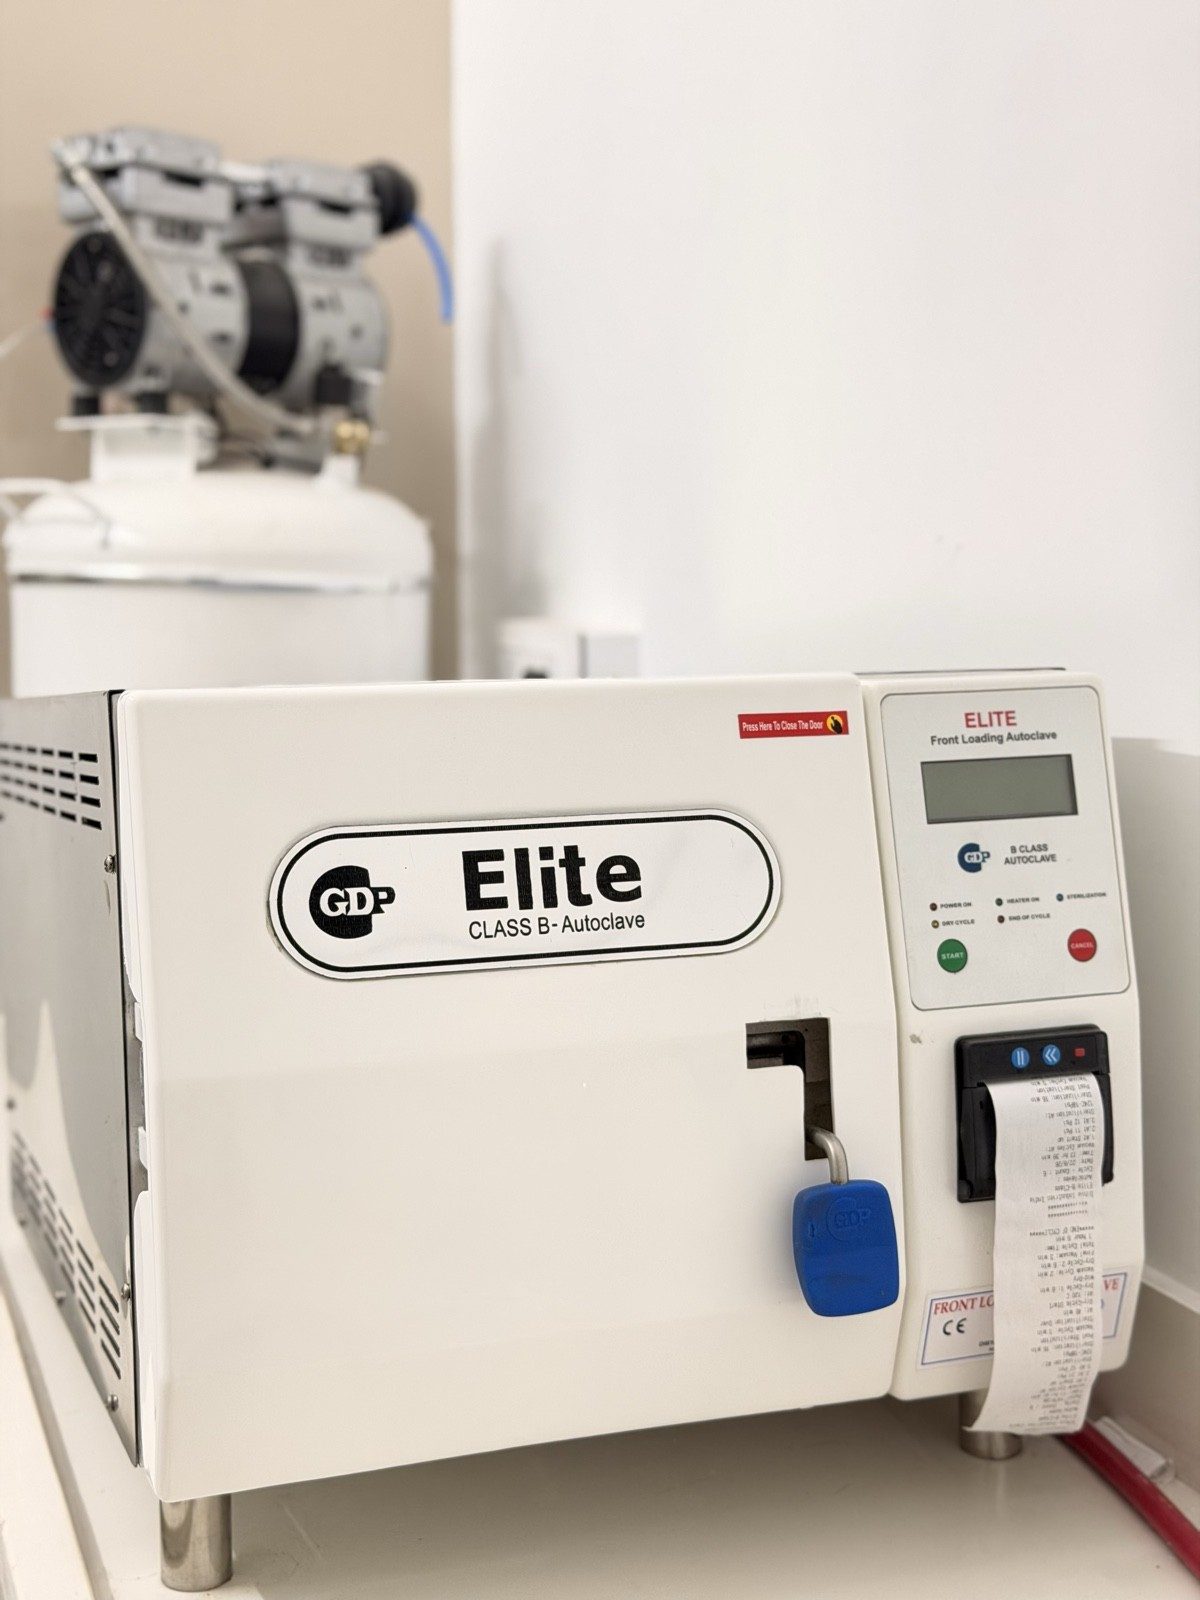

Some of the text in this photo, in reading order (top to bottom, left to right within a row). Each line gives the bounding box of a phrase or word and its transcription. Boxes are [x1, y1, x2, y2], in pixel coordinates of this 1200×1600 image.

[742, 720, 823, 732] Press Here To Close The Door
[964, 710, 1018, 728] ELITE
[930, 731, 1057, 746] Front Loading Autoclave
[1010, 844, 1048, 854] B CLASS
[1004, 854, 1057, 865] AUTOCLAVE
[461, 844, 643, 912] Elite
[319, 886, 396, 918] GDP
[468, 917, 532, 940] CLASS
[934, 1298, 978, 1314] FRONT
